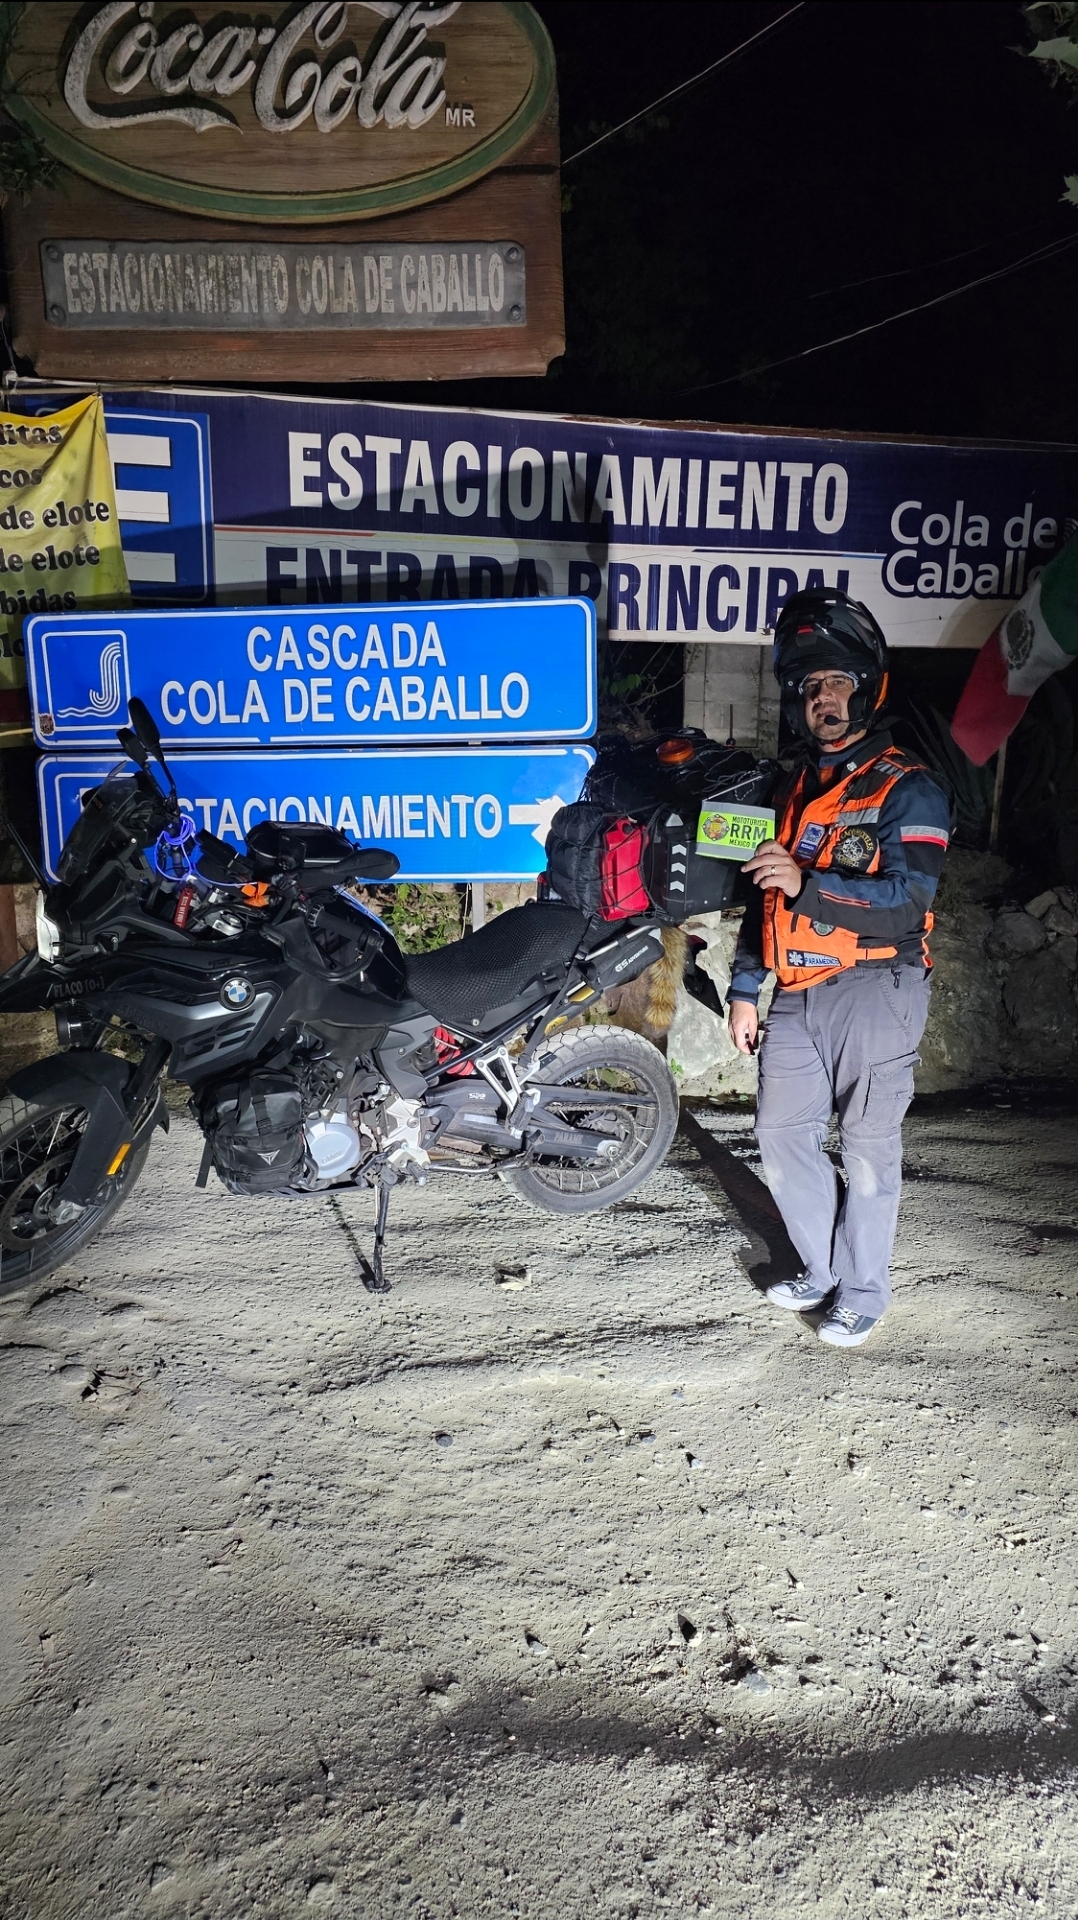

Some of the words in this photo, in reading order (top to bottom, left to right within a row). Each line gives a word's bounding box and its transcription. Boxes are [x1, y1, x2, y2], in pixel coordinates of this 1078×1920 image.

[445, 108, 476, 127] MR
[63, 252, 289, 314] ESTACIONAMIENTO
[296, 255, 358, 314] COLA
[363, 255, 394, 313] DE
[399, 252, 505, 313] CABALLO
[287, 430, 850, 535] ESTACIONAMIENTO
[0, 504, 34, 530] de
[42, 498, 110, 528] elote
[890, 500, 990, 547] Cola
[1003, 502, 1059, 549] de
[31, 544, 101, 571] elote
[246, 621, 447, 673] CASCADA
[160, 678, 270, 726] COLA
[283, 677, 335, 723] DE
[344, 671, 531, 723] CABALLO
[730, 823, 767, 841] RRM
[615, 958, 631, 973] GS
[53, 980, 84, 999] FLACO
